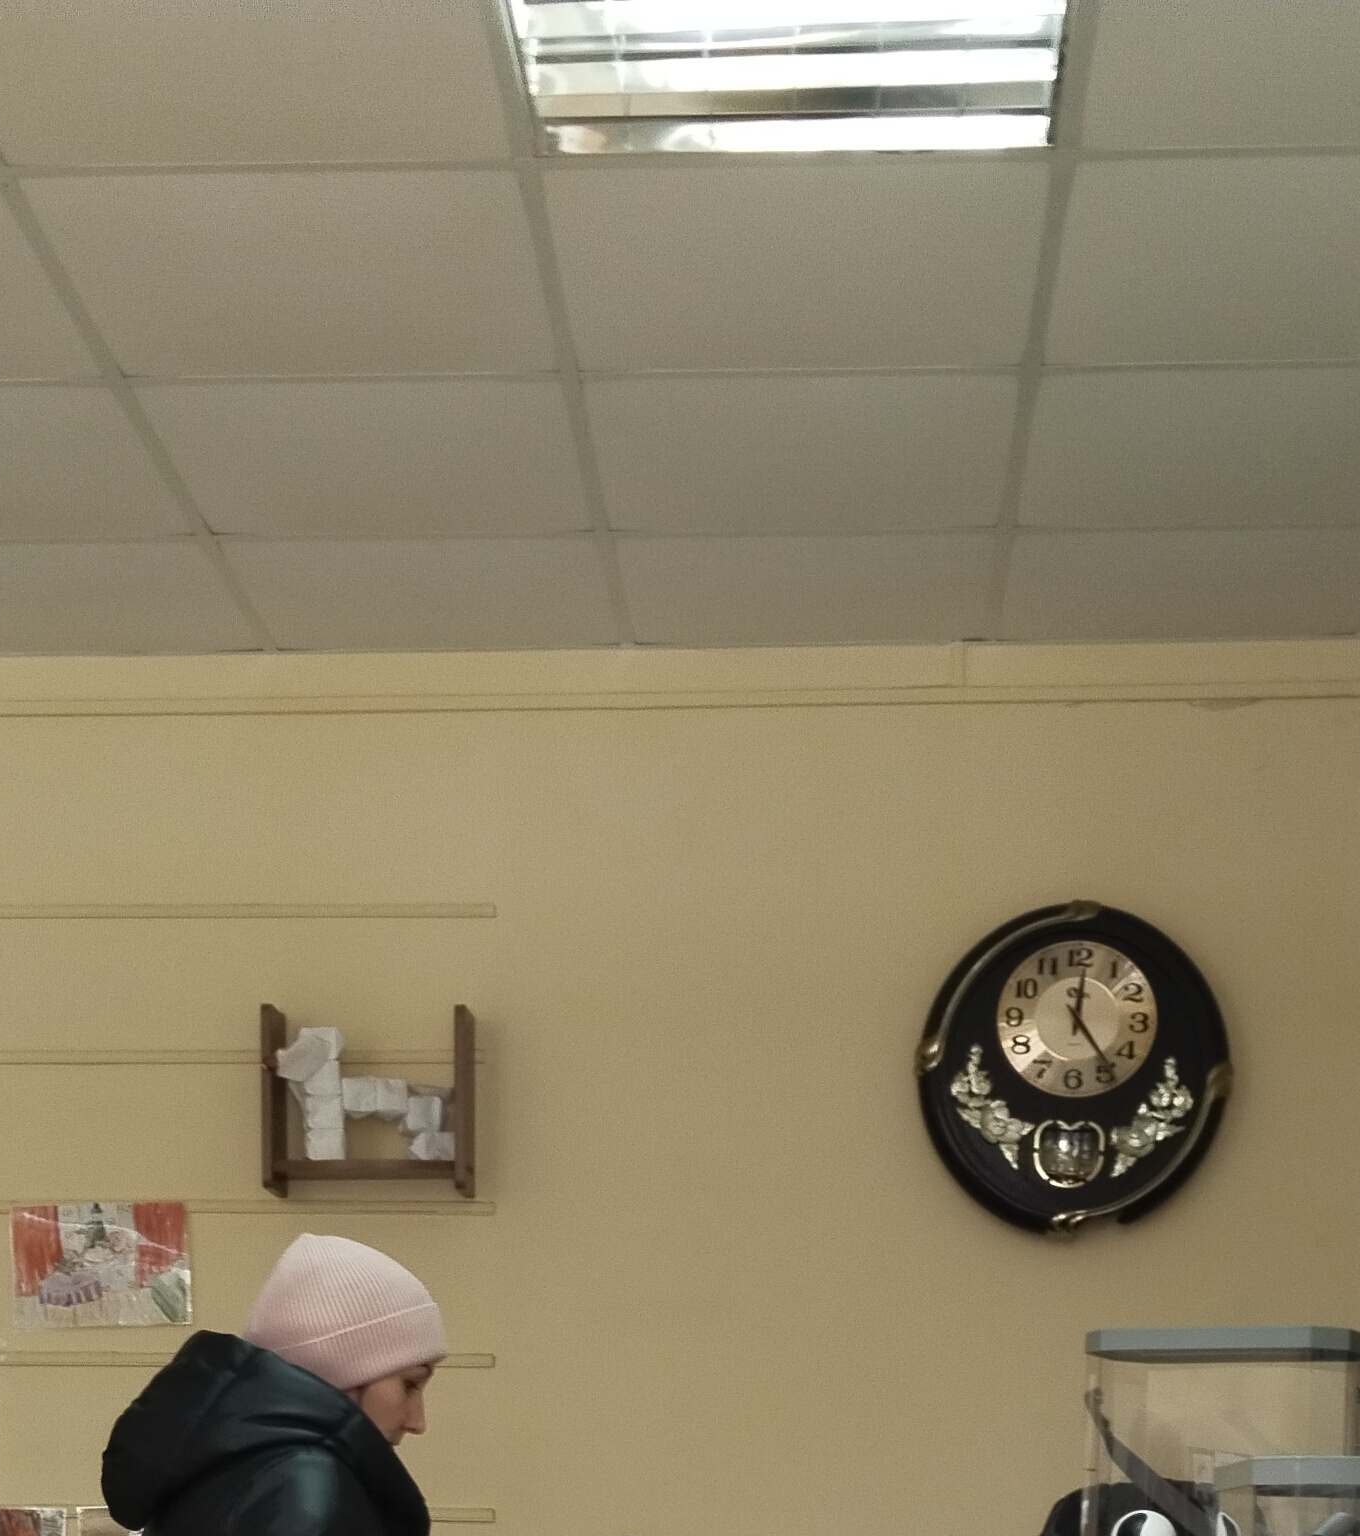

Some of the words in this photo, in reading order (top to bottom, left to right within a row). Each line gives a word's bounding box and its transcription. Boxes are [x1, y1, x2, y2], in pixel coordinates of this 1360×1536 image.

[1037, 958, 1059, 976] 11
[1067, 948, 1094, 968] 12
[1109, 959, 1120, 979] 1
[1015, 978, 1038, 999] 10
[1123, 982, 1144, 1003] 2
[1004, 1007, 1024, 1027] 9
[1130, 1012, 1149, 1034] 3
[1011, 1035, 1031, 1055] 8
[1117, 1041, 1137, 1060] 4
[1033, 1059, 1053, 1080] 7
[1063, 1068, 1083, 1090] 6
